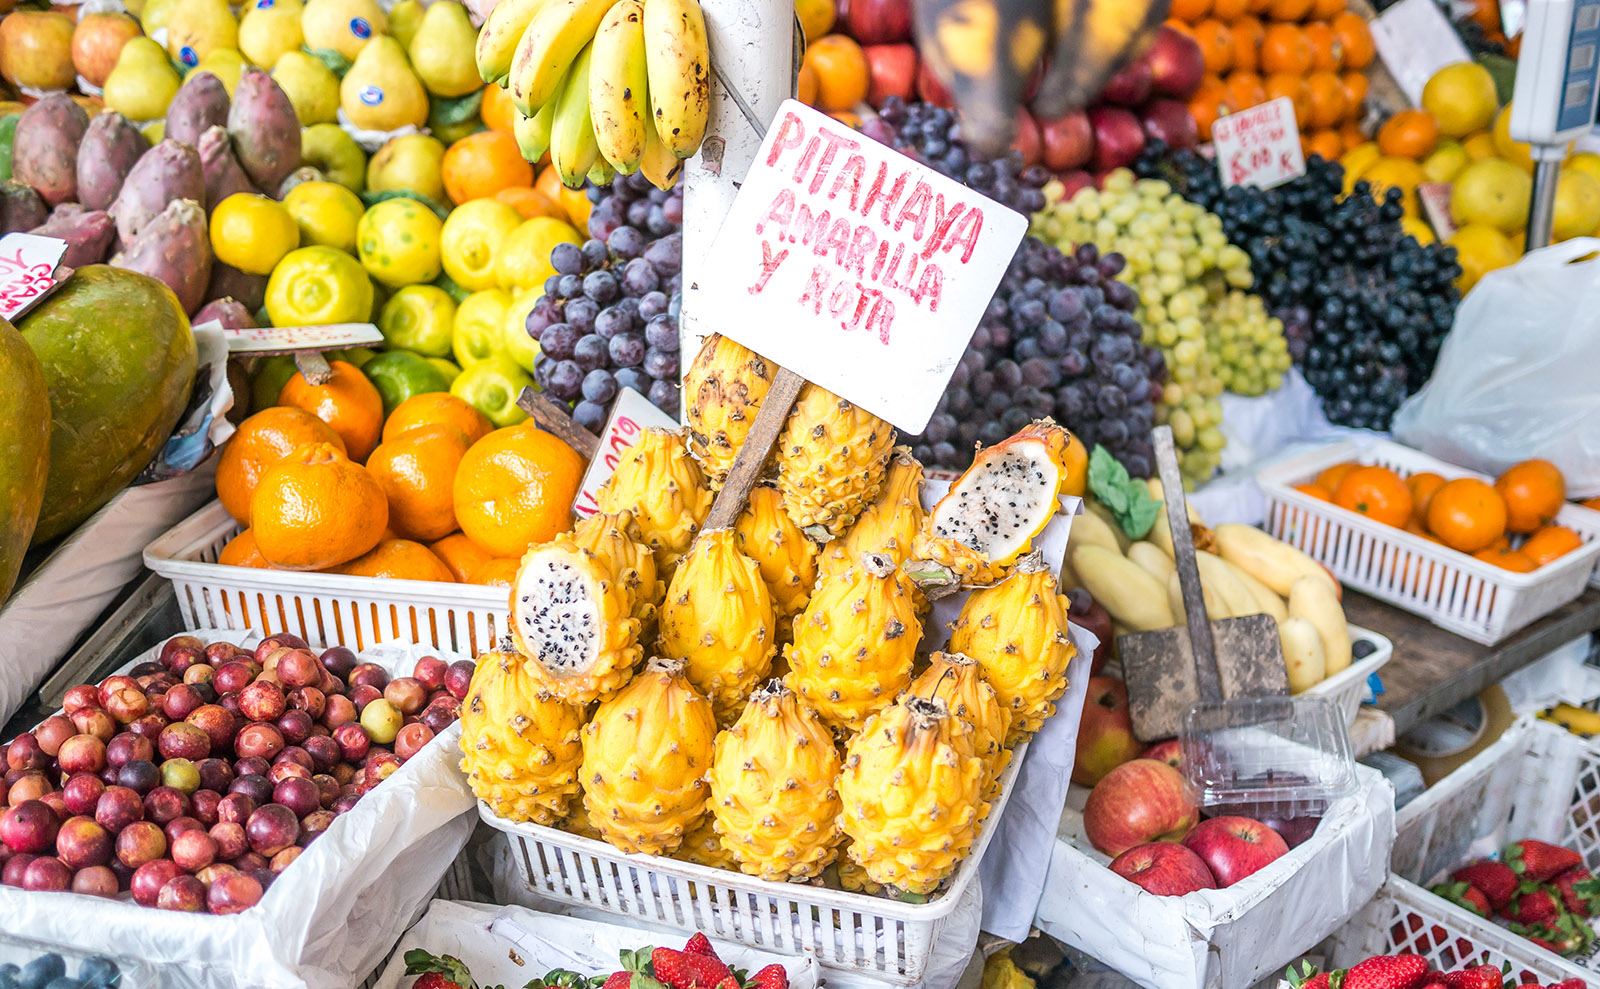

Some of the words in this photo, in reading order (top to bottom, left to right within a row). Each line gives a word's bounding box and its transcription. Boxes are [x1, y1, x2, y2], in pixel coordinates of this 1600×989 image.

[756, 188, 943, 313] AMARILLA
[766, 112, 983, 264] PITAHAYA
[748, 240, 789, 295] Y
[797, 264, 896, 346] ROJA
